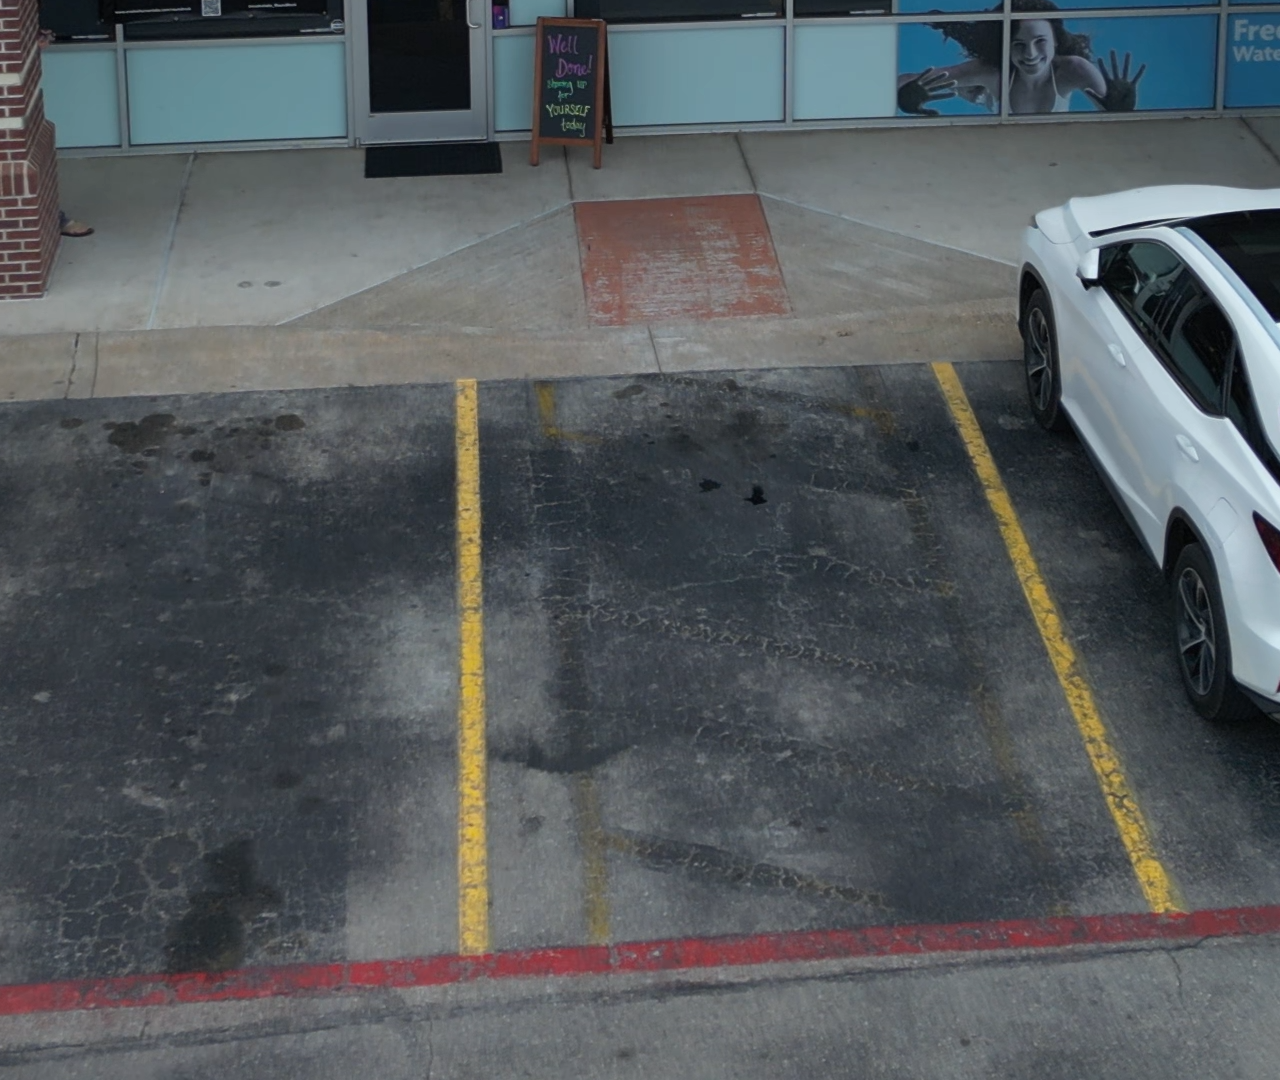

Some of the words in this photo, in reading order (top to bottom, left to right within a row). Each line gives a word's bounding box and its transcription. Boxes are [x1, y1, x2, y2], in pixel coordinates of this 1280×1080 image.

[547, 33, 579, 55] Well
[555, 54, 593, 78] Done!
[546, 103, 591, 118] YOURSELF
[561, 118, 587, 138] today
